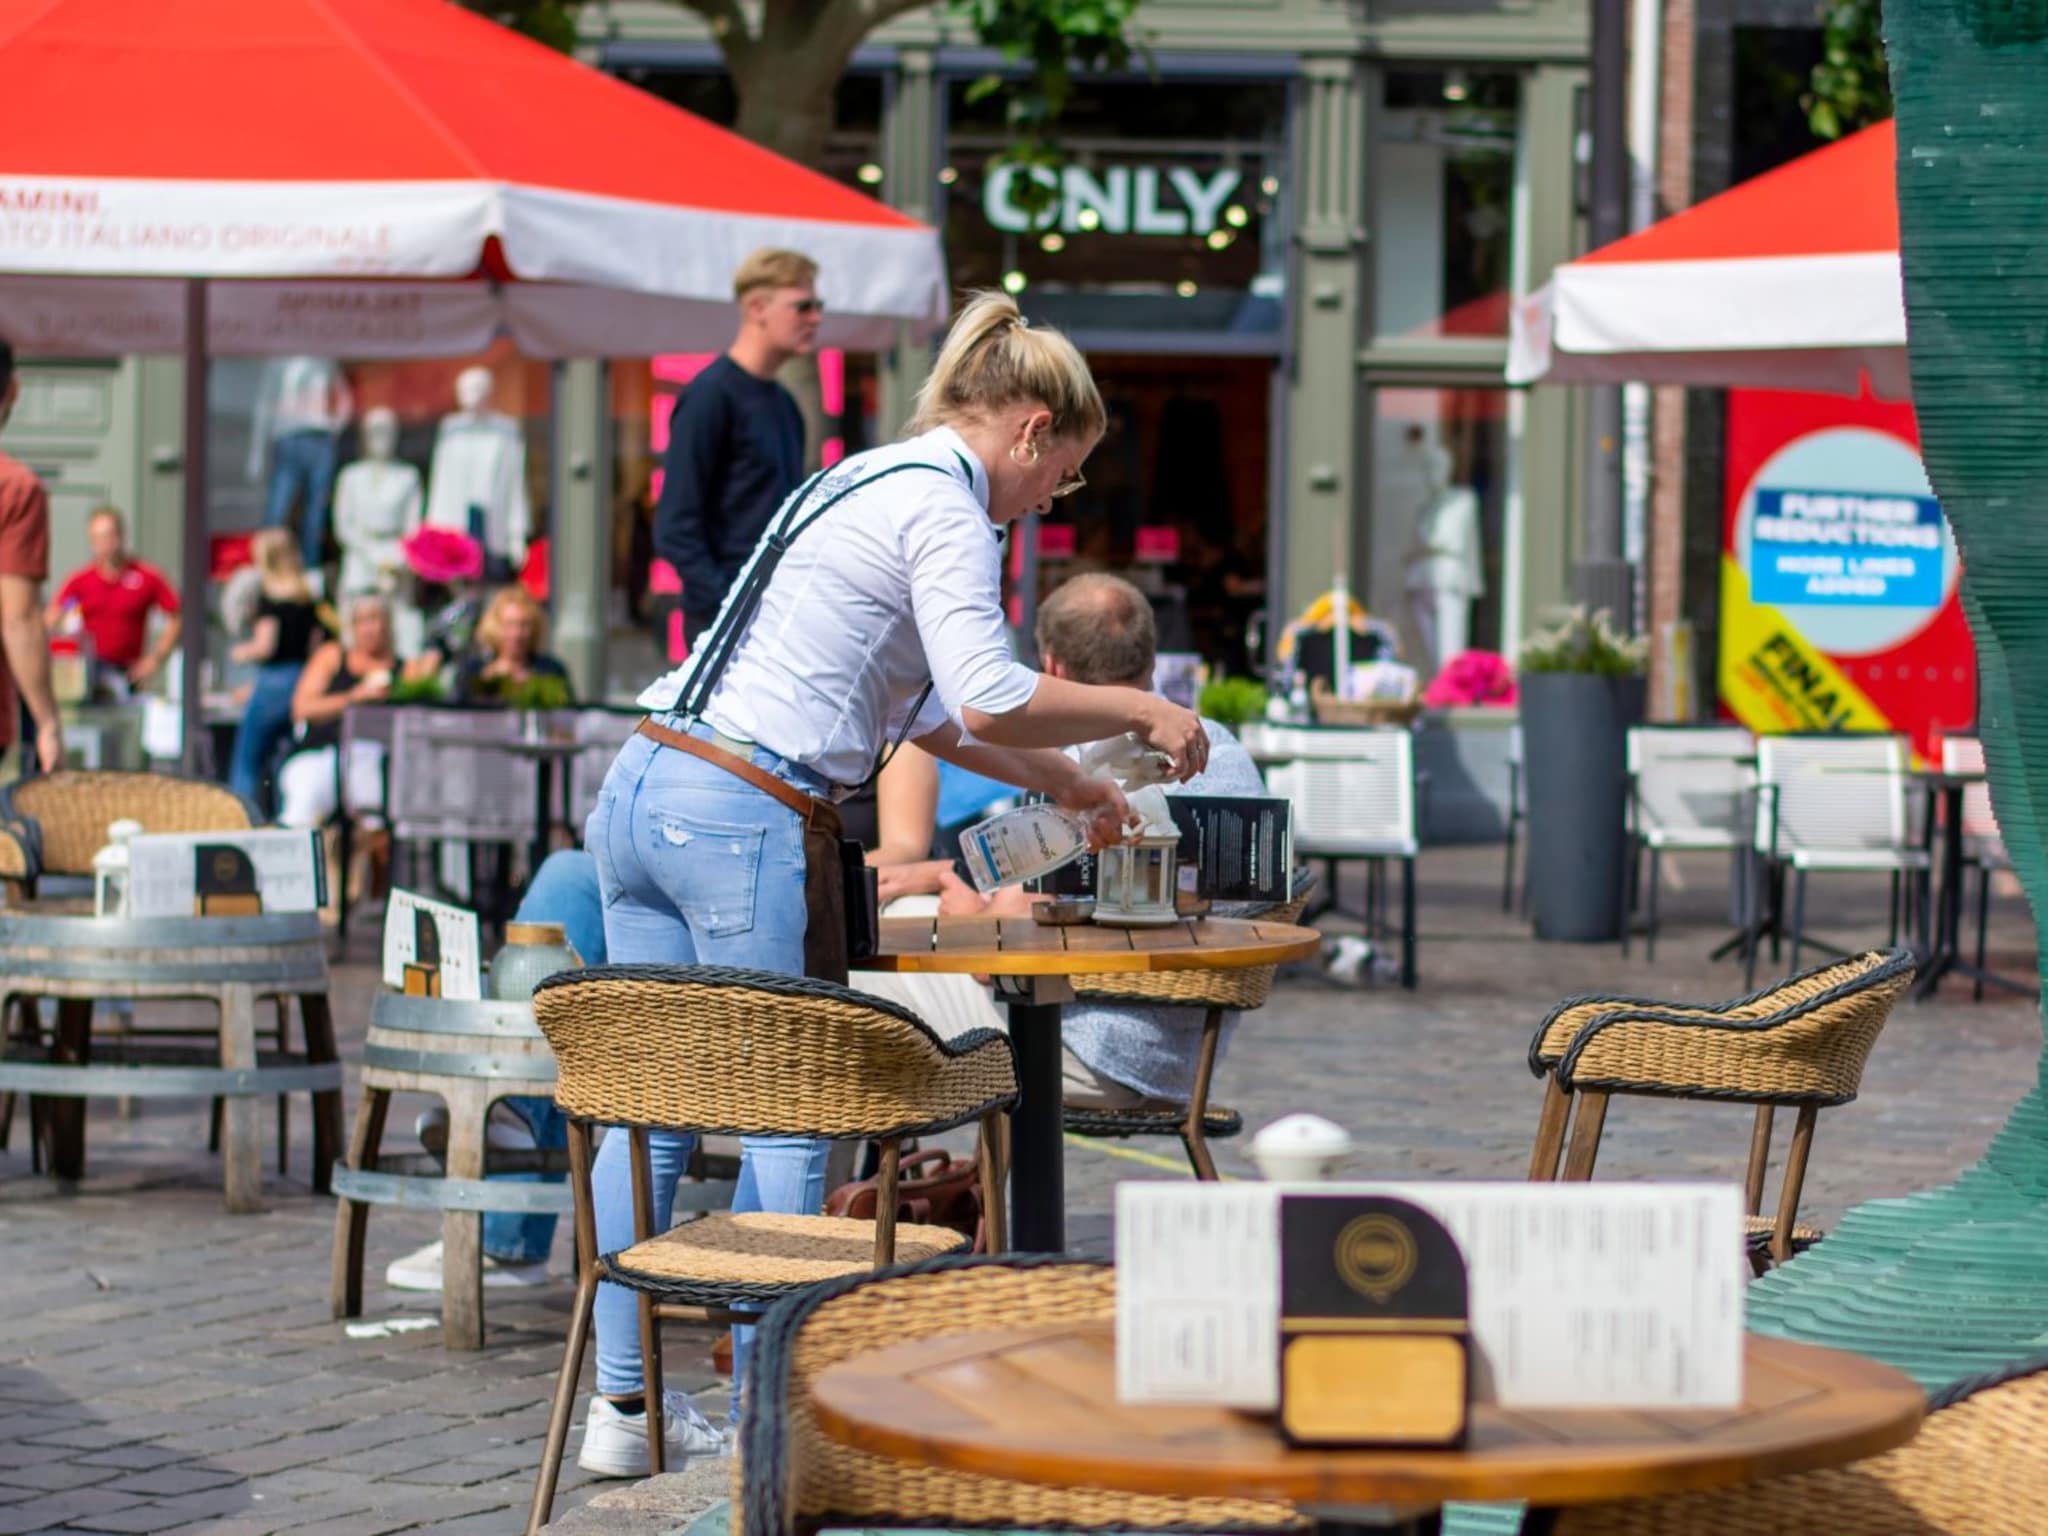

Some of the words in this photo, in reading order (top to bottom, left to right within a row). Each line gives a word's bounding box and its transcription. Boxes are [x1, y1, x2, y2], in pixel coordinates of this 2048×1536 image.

[983, 163, 1241, 234] ONLY
[60, 219, 211, 249] ITALIANO
[218, 221, 391, 250] ORIGINALE
[1781, 495, 1918, 523] FURTHER
[1756, 517, 1939, 549] REDUCTIONS
